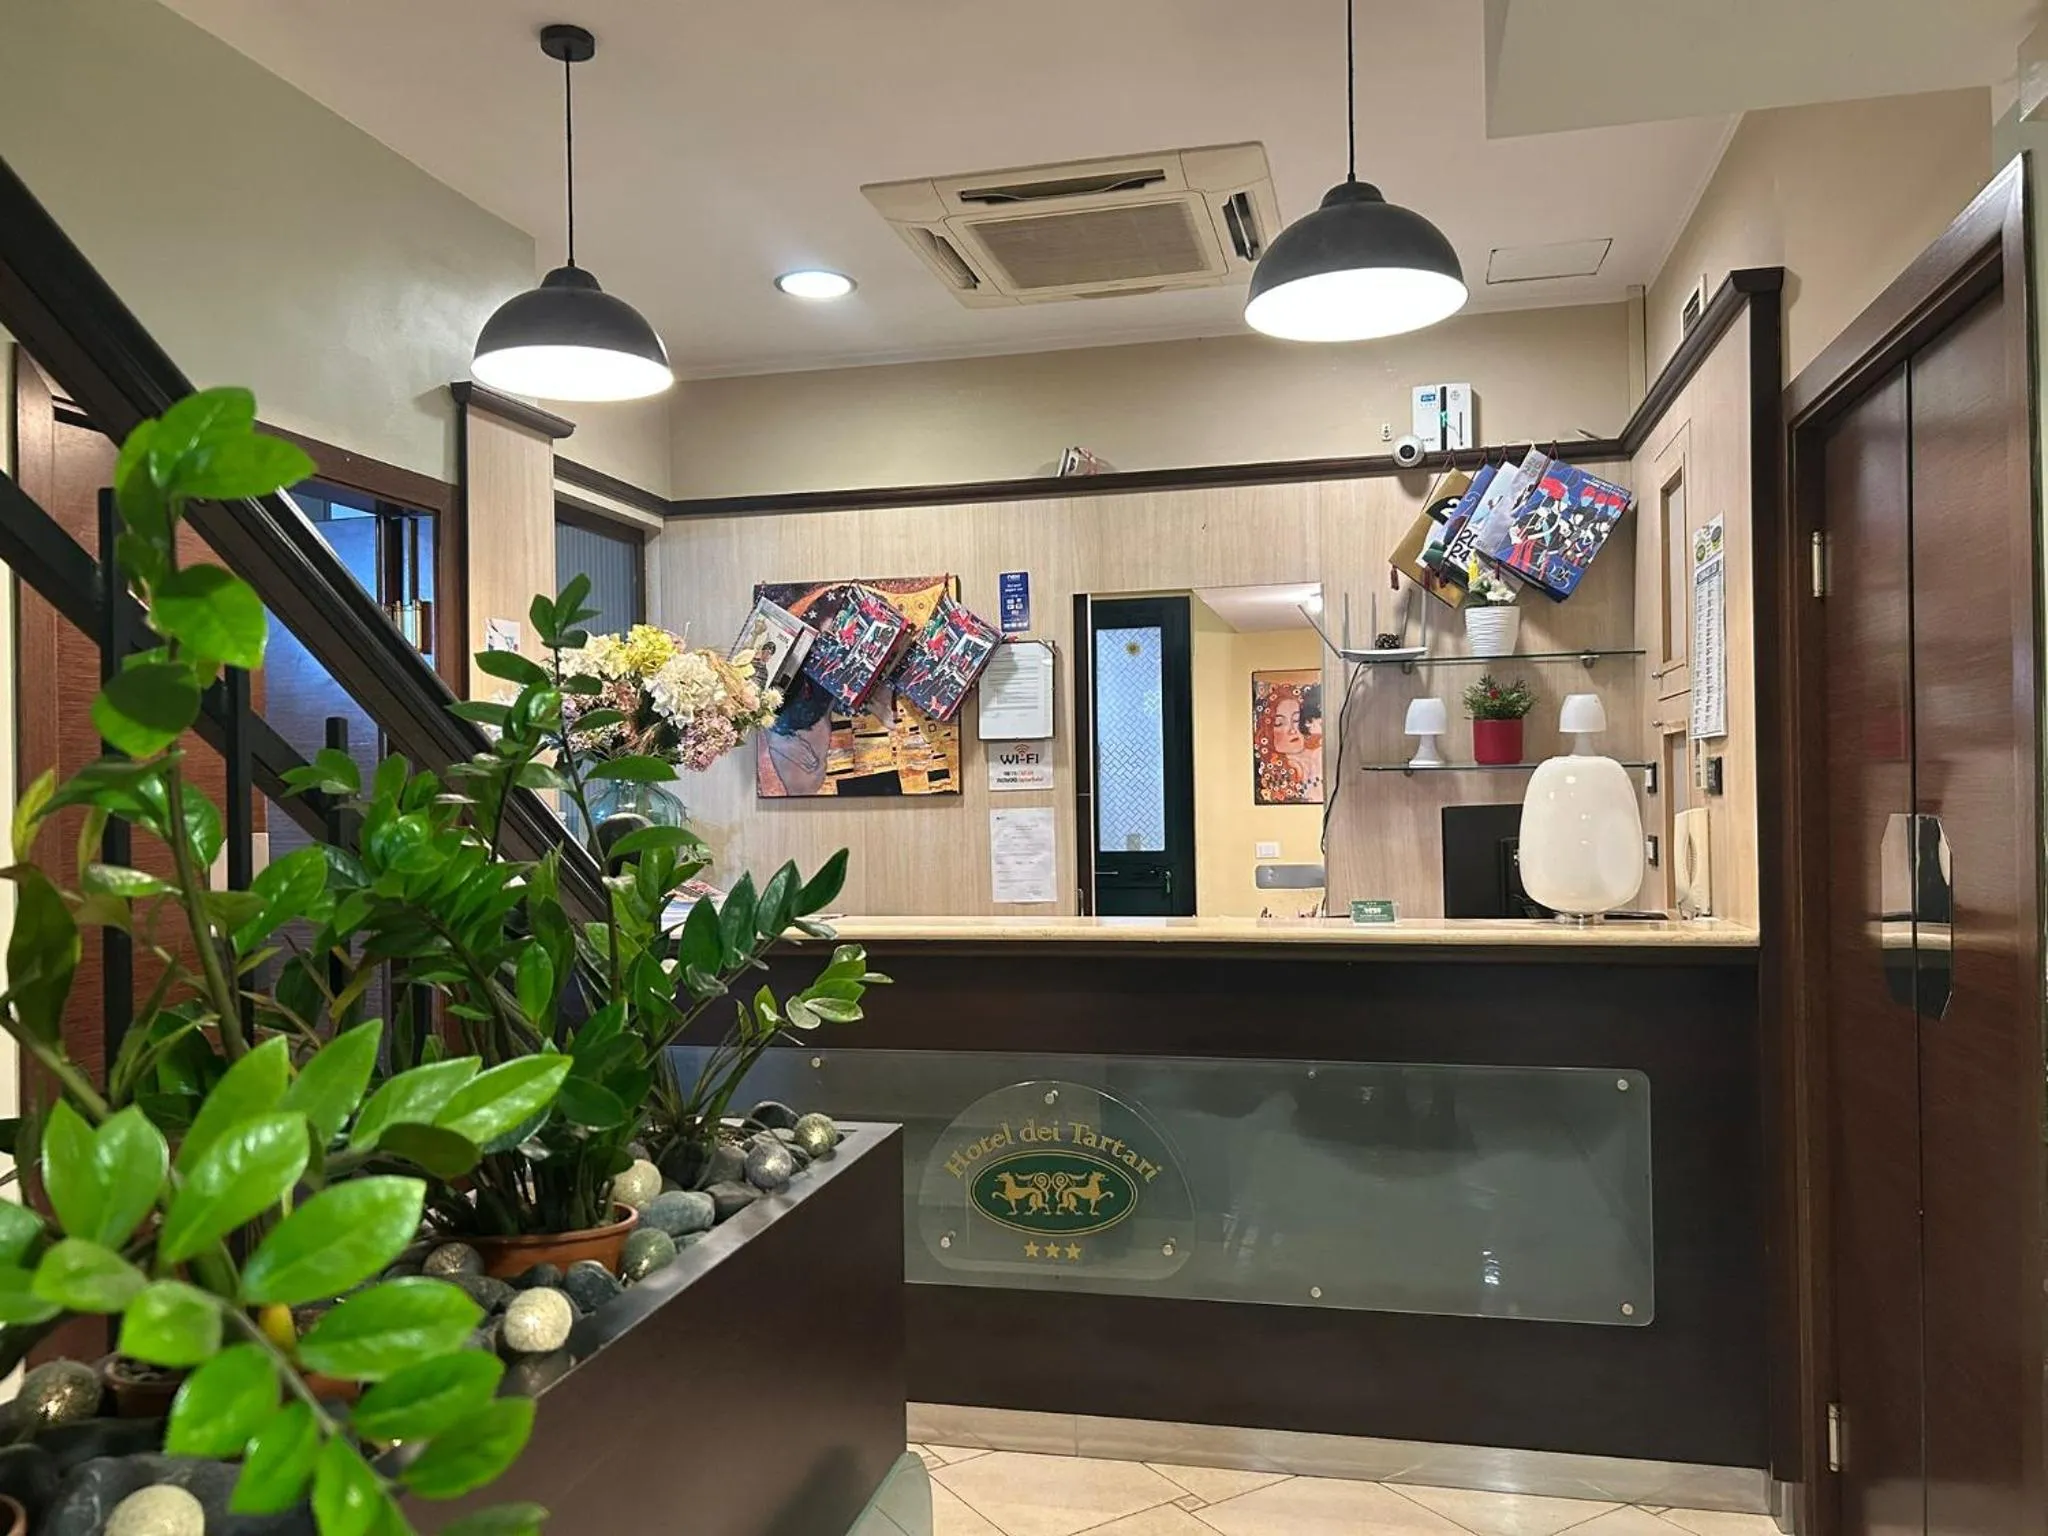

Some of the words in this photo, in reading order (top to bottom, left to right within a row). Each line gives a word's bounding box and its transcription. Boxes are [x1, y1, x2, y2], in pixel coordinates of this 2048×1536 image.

[1449, 543, 1471, 563] 24
[1000, 753, 1039, 765] WI-FI
[943, 1121, 1017, 1179] Hotel
[1019, 1117, 1062, 1143] dei
[1068, 1121, 1163, 1184] Tartari
